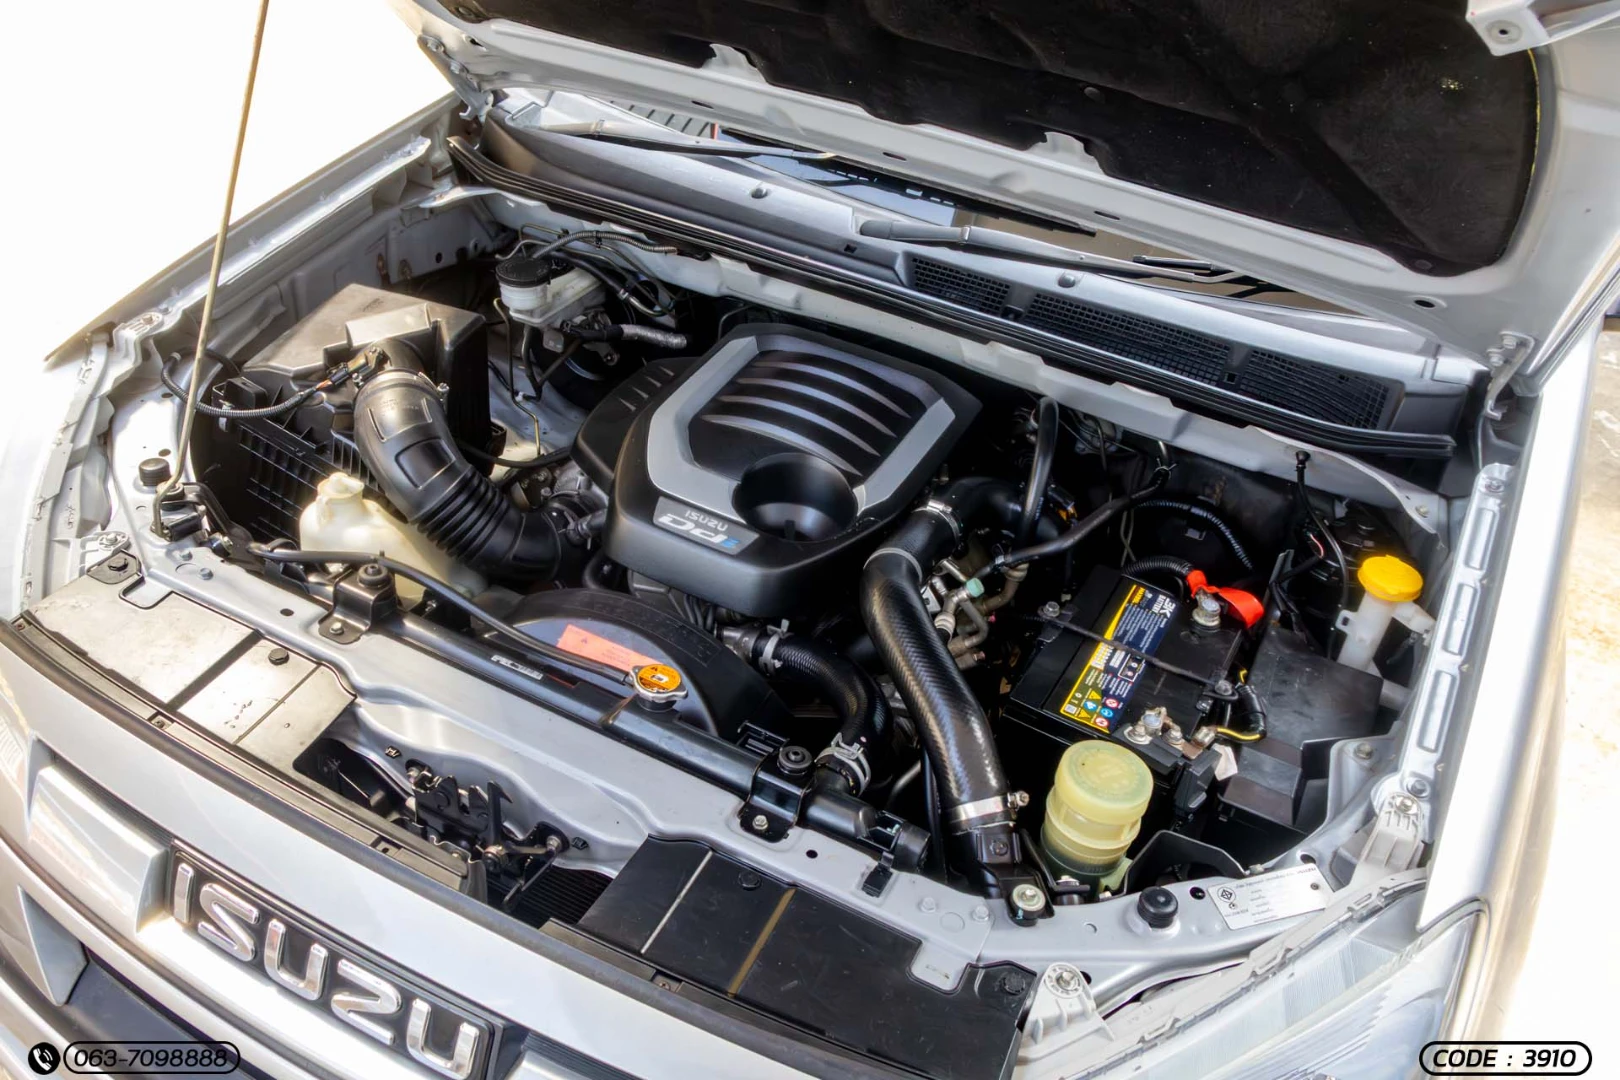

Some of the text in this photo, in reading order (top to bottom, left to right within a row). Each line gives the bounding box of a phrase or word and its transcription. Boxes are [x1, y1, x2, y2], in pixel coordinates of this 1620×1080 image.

[685, 510, 728, 531] ISUZU
[1159, 598, 1176, 618] 3K
[173, 863, 481, 1080] ISUZU
